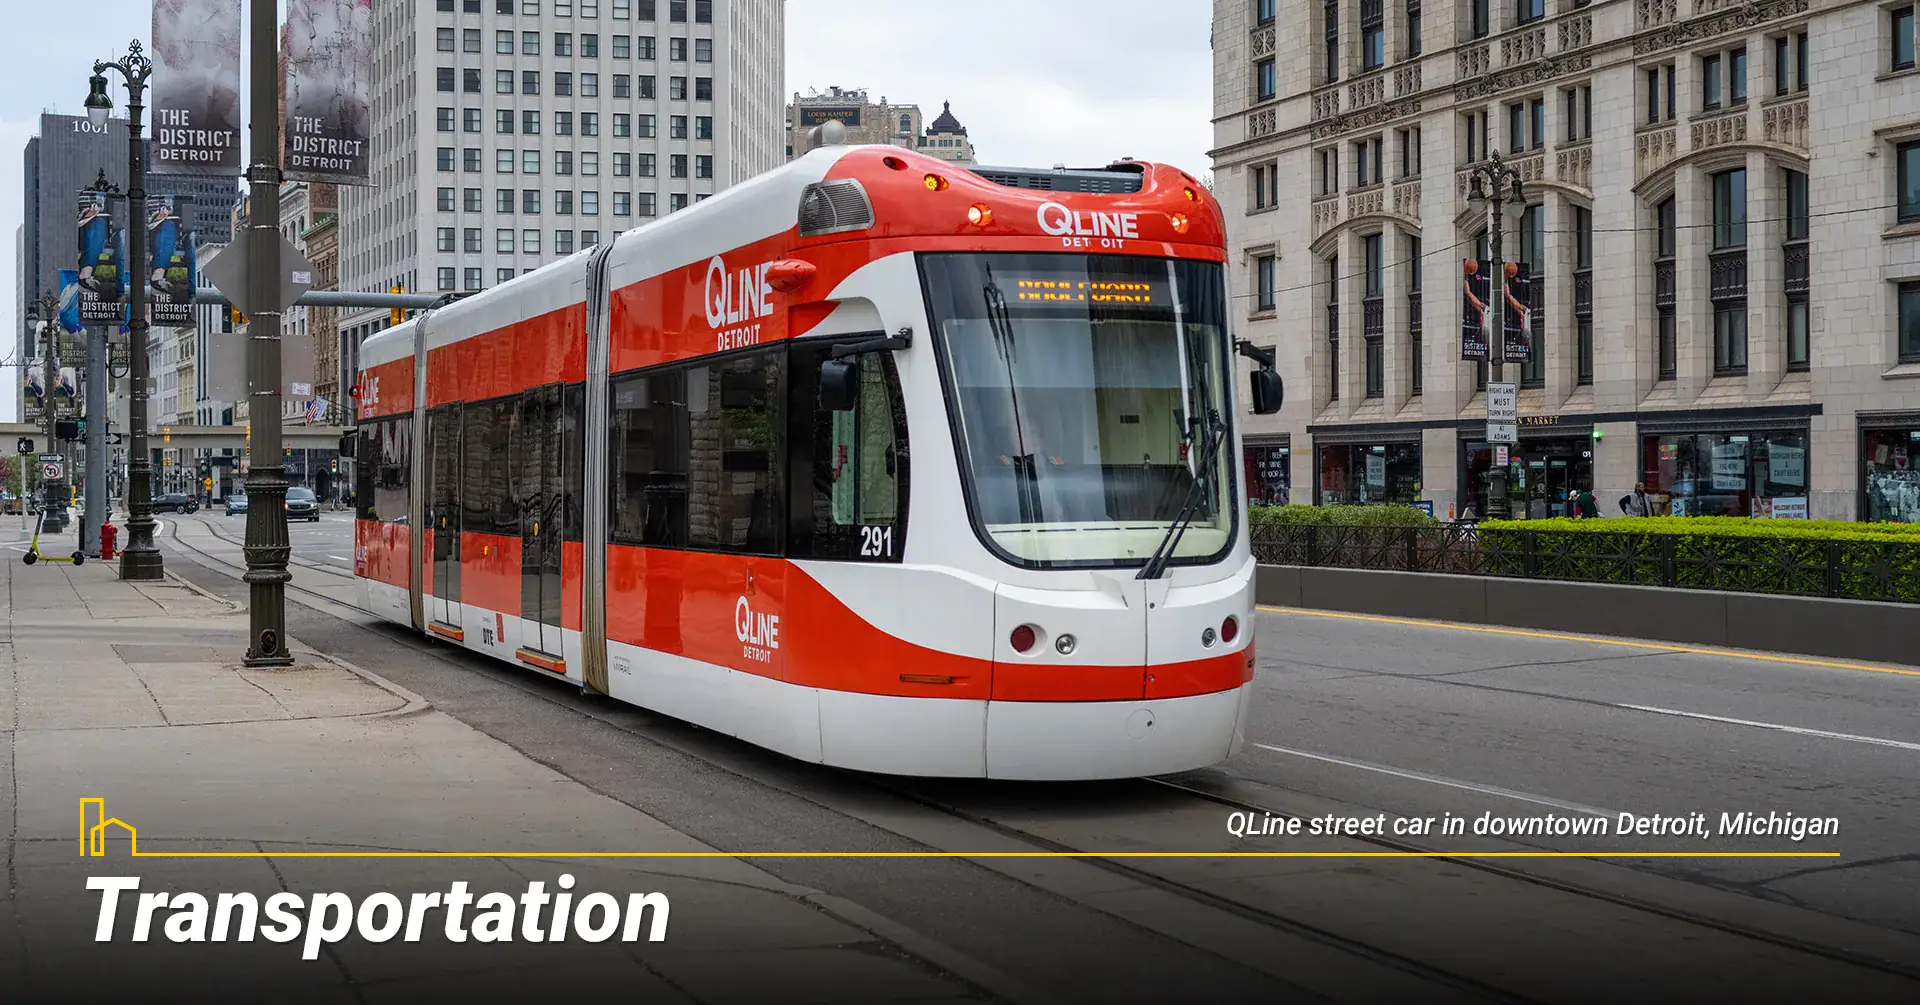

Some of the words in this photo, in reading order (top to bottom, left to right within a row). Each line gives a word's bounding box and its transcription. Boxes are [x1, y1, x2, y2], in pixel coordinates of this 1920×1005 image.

[160, 109, 189, 126] THE
[294, 116, 322, 134] THE
[160, 128, 233, 147] DISTRICT
[293, 135, 362, 156] DISTRICT
[160, 148, 223, 161] DETROIT
[292, 154, 353, 170] DETROIT
[1036, 202, 1139, 239] QLINE
[1062, 237, 1124, 248] DETOIT
[82, 292, 99, 301] THE
[155, 293, 171, 303] THE
[704, 254, 774, 329] QLINE
[82, 302, 121, 312] DISTRICT
[155, 303, 193, 313] DISTRICT
[717, 323, 761, 352] DETROIT
[1494, 398, 1510, 406] MUST
[1527, 415, 1559, 425] MARKET
[860, 526, 892, 556] 291
[735, 595, 779, 649] QLINE
[482, 627, 494, 646] DTE
[743, 645, 771, 663] DETROIT
